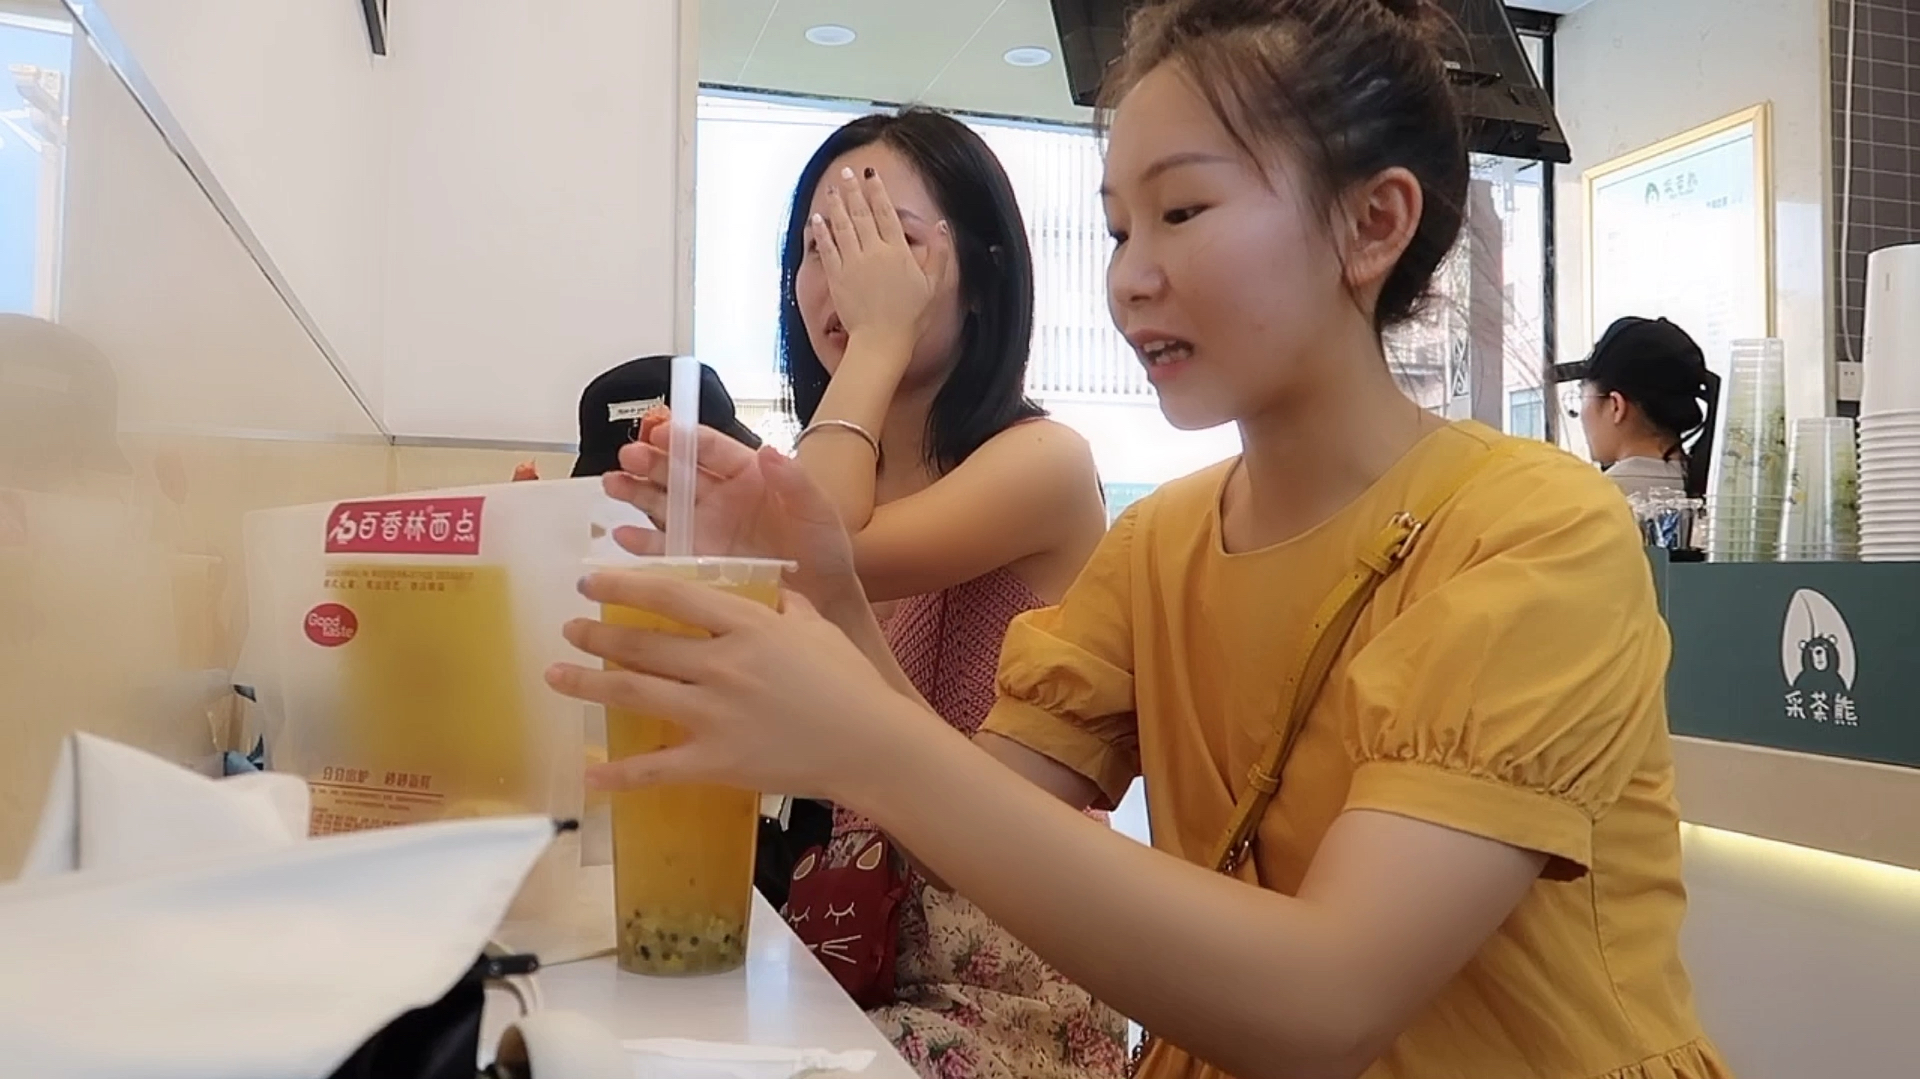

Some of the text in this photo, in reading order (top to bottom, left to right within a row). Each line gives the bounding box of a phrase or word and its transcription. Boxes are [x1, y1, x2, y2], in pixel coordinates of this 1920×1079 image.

[308, 613, 341, 626] Good
[323, 624, 354, 639] taste
[1784, 690, 1858, 726] 采茶熊
